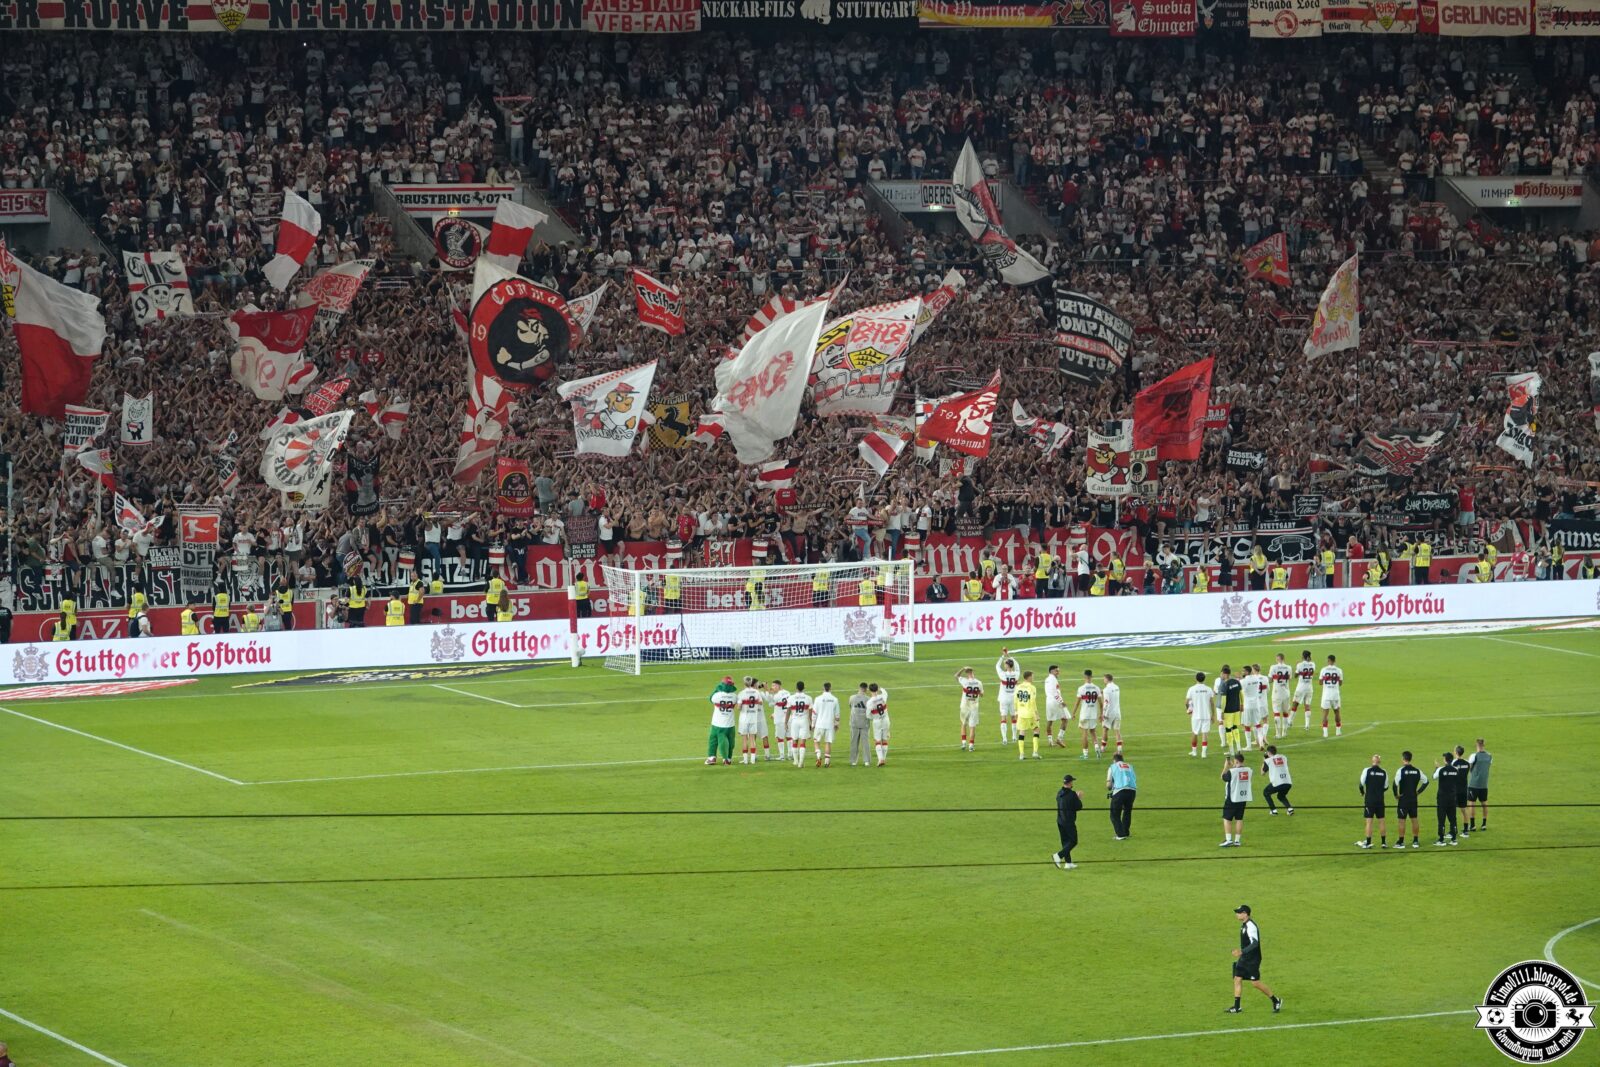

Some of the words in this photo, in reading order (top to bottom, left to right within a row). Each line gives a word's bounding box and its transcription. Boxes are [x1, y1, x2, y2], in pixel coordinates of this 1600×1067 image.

[64, 0, 189, 30] KURVE
[268, 0, 588, 31] NECKARSTADION
[701, 1, 796, 19] NECKAR-FILS
[837, 1, 918, 19] STUTTGART
[1141, 2, 1192, 16] Suebia
[1442, 6, 1528, 27] GERLINGEN
[594, 13, 697, 31] VFB-FANS
[397, 194, 470, 205] BRUSTRING
[1491, 189, 1513, 198] MHP
[1260, 521, 1297, 529] STUTTGART
[709, 541, 733, 553] 97
[1371, 592, 1445, 621] Hofbräu
[1000, 605, 1077, 633] Hofbräu
[186, 642, 271, 672] Hofbräu
